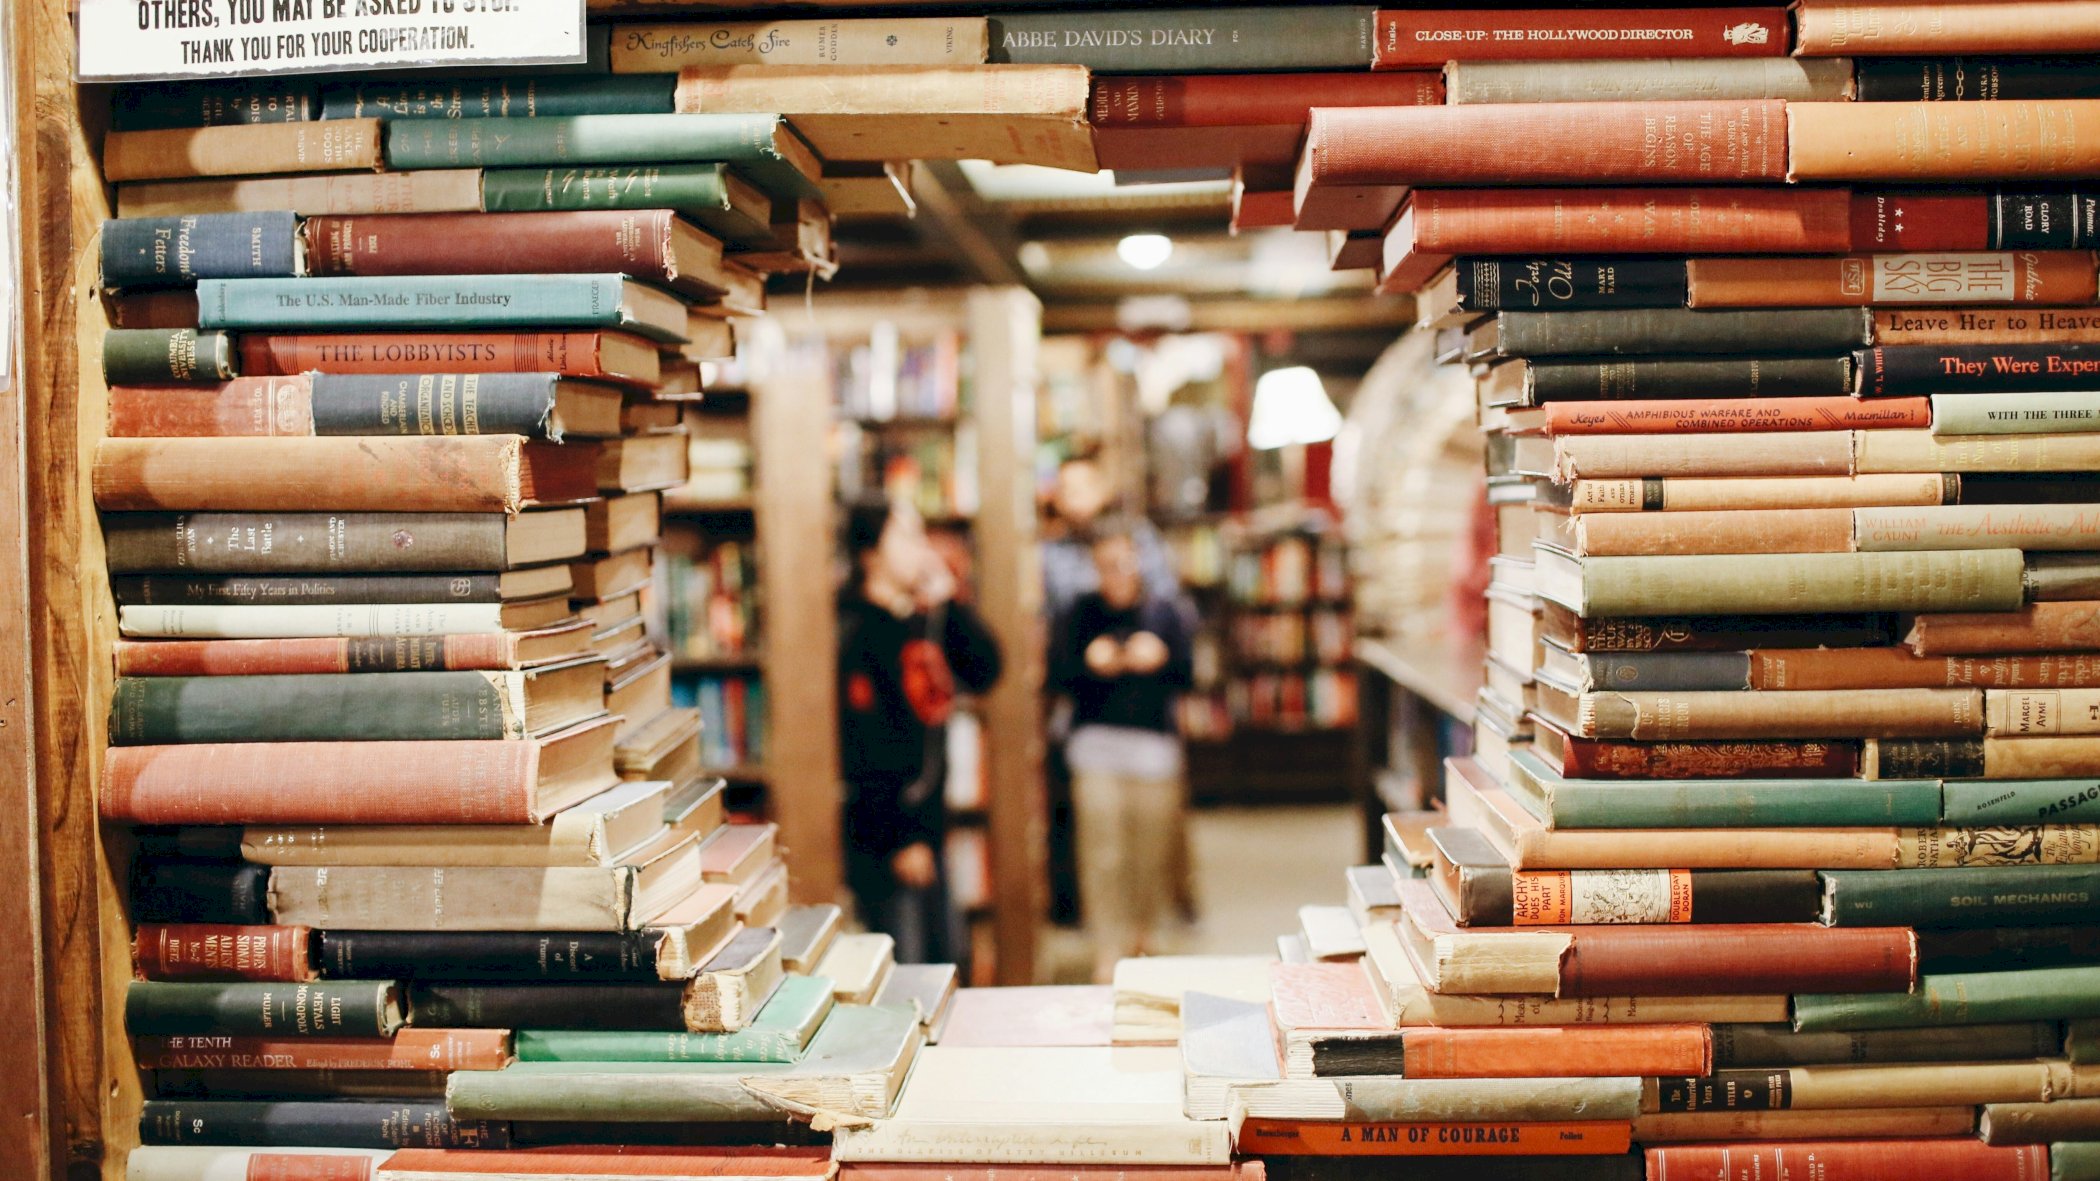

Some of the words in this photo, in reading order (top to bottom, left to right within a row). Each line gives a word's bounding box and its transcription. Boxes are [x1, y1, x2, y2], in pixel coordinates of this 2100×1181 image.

[138, 0, 220, 30] OTHERS,
[272, 0, 315, 22] MAY
[181, 38, 234, 64] THANK
[241, 35, 271, 60] YOU
[277, 34, 305, 59] FOR
[311, 30, 353, 56] YOUR
[358, 25, 475, 54] COOPERATION.
[626, 29, 706, 57] Kingfishers
[709, 29, 755, 52] Catch
[758, 29, 791, 54] Fire
[818, 25, 826, 58] RUMER
[830, 23, 839, 61] GODDEN
[946, 26, 954, 54] VIKING
[1002, 31, 1057, 48] ABBE
[1063, 29, 1143, 47] DAVID'S
[1151, 28, 1216, 46] DIARY
[1387, 20, 1396, 52] Tuska
[1415, 29, 1489, 41] CLOSE-UP:
[1494, 29, 1524, 41] THE
[1528, 28, 1619, 41] HOLLYWOOD
[1620, 27, 1694, 40] DIRECTOR
[1700, 112, 1712, 139] THE
[1645, 117, 1657, 167] BEGINS
[1665, 115, 1677, 168] REASON
[1684, 132, 1695, 150] OF
[1727, 120, 1736, 161] DURANT
[1700, 143, 1712, 171] AGE
[1875, 196, 1885, 243] Doubleday
[2024, 205, 2033, 231] ROAD
[2041, 202, 2049, 234] GLORY
[154, 228, 172, 274] Fetters
[178, 217, 200, 281] Freedom's
[251, 227, 262, 266] SMITH
[1547, 261, 1574, 300] Odd
[1598, 267, 1606, 294] MARY
[1607, 267, 1615, 294] BARD
[1884, 260, 1920, 295] SKY
[1926, 260, 1962, 293] BIG
[1967, 259, 2010, 292] THE
[2020, 252, 2045, 300] Guthrie
[276, 294, 301, 307] The
[305, 293, 334, 307] U.S.
[339, 292, 410, 306] Man-Made
[416, 292, 451, 306] Fiber
[455, 292, 512, 308] Industry
[592, 280, 600, 316] PRAEGER
[1890, 314, 1948, 331] Leave
[1959, 314, 1995, 331] Her
[2007, 314, 2027, 330] to
[2039, 313, 2100, 331] Heave
[168, 332, 181, 380] COLUMBIA
[186, 339, 196, 370] PRESS
[315, 345, 364, 362] THE
[373, 343, 496, 362] LOBBYISTS
[1940, 357, 1987, 376] They
[1992, 356, 2039, 374] Were
[443, 379, 454, 399] AND
[465, 379, 476, 396] THE
[1570, 413, 1606, 428] Keyes
[1626, 410, 1695, 421] AMPHIBIOUS
[1700, 409, 1753, 419] WARFARE
[1757, 409, 1781, 418] AND
[1675, 419, 1735, 429] COMBINED
[1740, 418, 1813, 428] OPERATIONS
[1844, 410, 1908, 422] Macmillan
[1988, 410, 2018, 420] WITH
[2024, 410, 2047, 420] THE
[2052, 409, 2093, 419] THREE
[1597, 484, 1605, 503] Faith
[1865, 517, 1927, 529] WILLIAM
[1873, 531, 1921, 542] GAUNT
[1937, 523, 1964, 536] THE
[1968, 512, 2051, 537] Aesthetic
[228, 527, 239, 551] The
[244, 527, 256, 551] Last
[261, 522, 273, 555] Battle
[233, 583, 257, 600] Fifty
[260, 583, 286, 596] Years
[289, 583, 298, 596] in
[301, 583, 336, 596] Politics
[1777, 659, 1786, 688] PETER
[2020, 696, 2030, 733] MARCEL
[1976, 790, 2016, 811] ROSENFELD
[2038, 783, 2100, 819] PASSAG
[1929, 828, 1939, 868] NATHA
[1515, 876, 1529, 918] ARCHY
[1530, 876, 1540, 892] HIS
[1558, 872, 1567, 906] MARQUIS
[1672, 874, 1682, 921] DOUBLEDAY
[1541, 885, 1551, 911] PART
[1682, 884, 1690, 912] DORAN
[1854, 901, 1873, 909] WU
[1951, 896, 1987, 906] SOIL
[1994, 892, 2089, 905] MECHANICS
[1558, 908, 1566, 923] DON
[169, 939, 180, 962] DIETZ
[236, 935, 249, 971] SIONAL
[554, 952, 563, 962] of
[584, 953, 593, 961] A
[262, 992, 272, 1028] MULLER
[296, 985, 309, 1035] MONOPOLY
[313, 992, 324, 1030] METALS
[331, 997, 342, 1025] LIGHT
[1532, 1003, 1541, 1015] of
[188, 1036, 232, 1049] TENTH
[430, 1043, 441, 1059] Sc
[160, 1054, 226, 1068] GALAXY
[231, 1054, 297, 1068] READER
[193, 1118, 204, 1133] Sc
[401, 1108, 410, 1136] Edited
[424, 1112, 433, 1146] FICTION
[1341, 1128, 1352, 1143] A
[1361, 1127, 1398, 1143] MAN
[1408, 1127, 1430, 1143] OF
[1438, 1127, 1520, 1143] COURAGE
